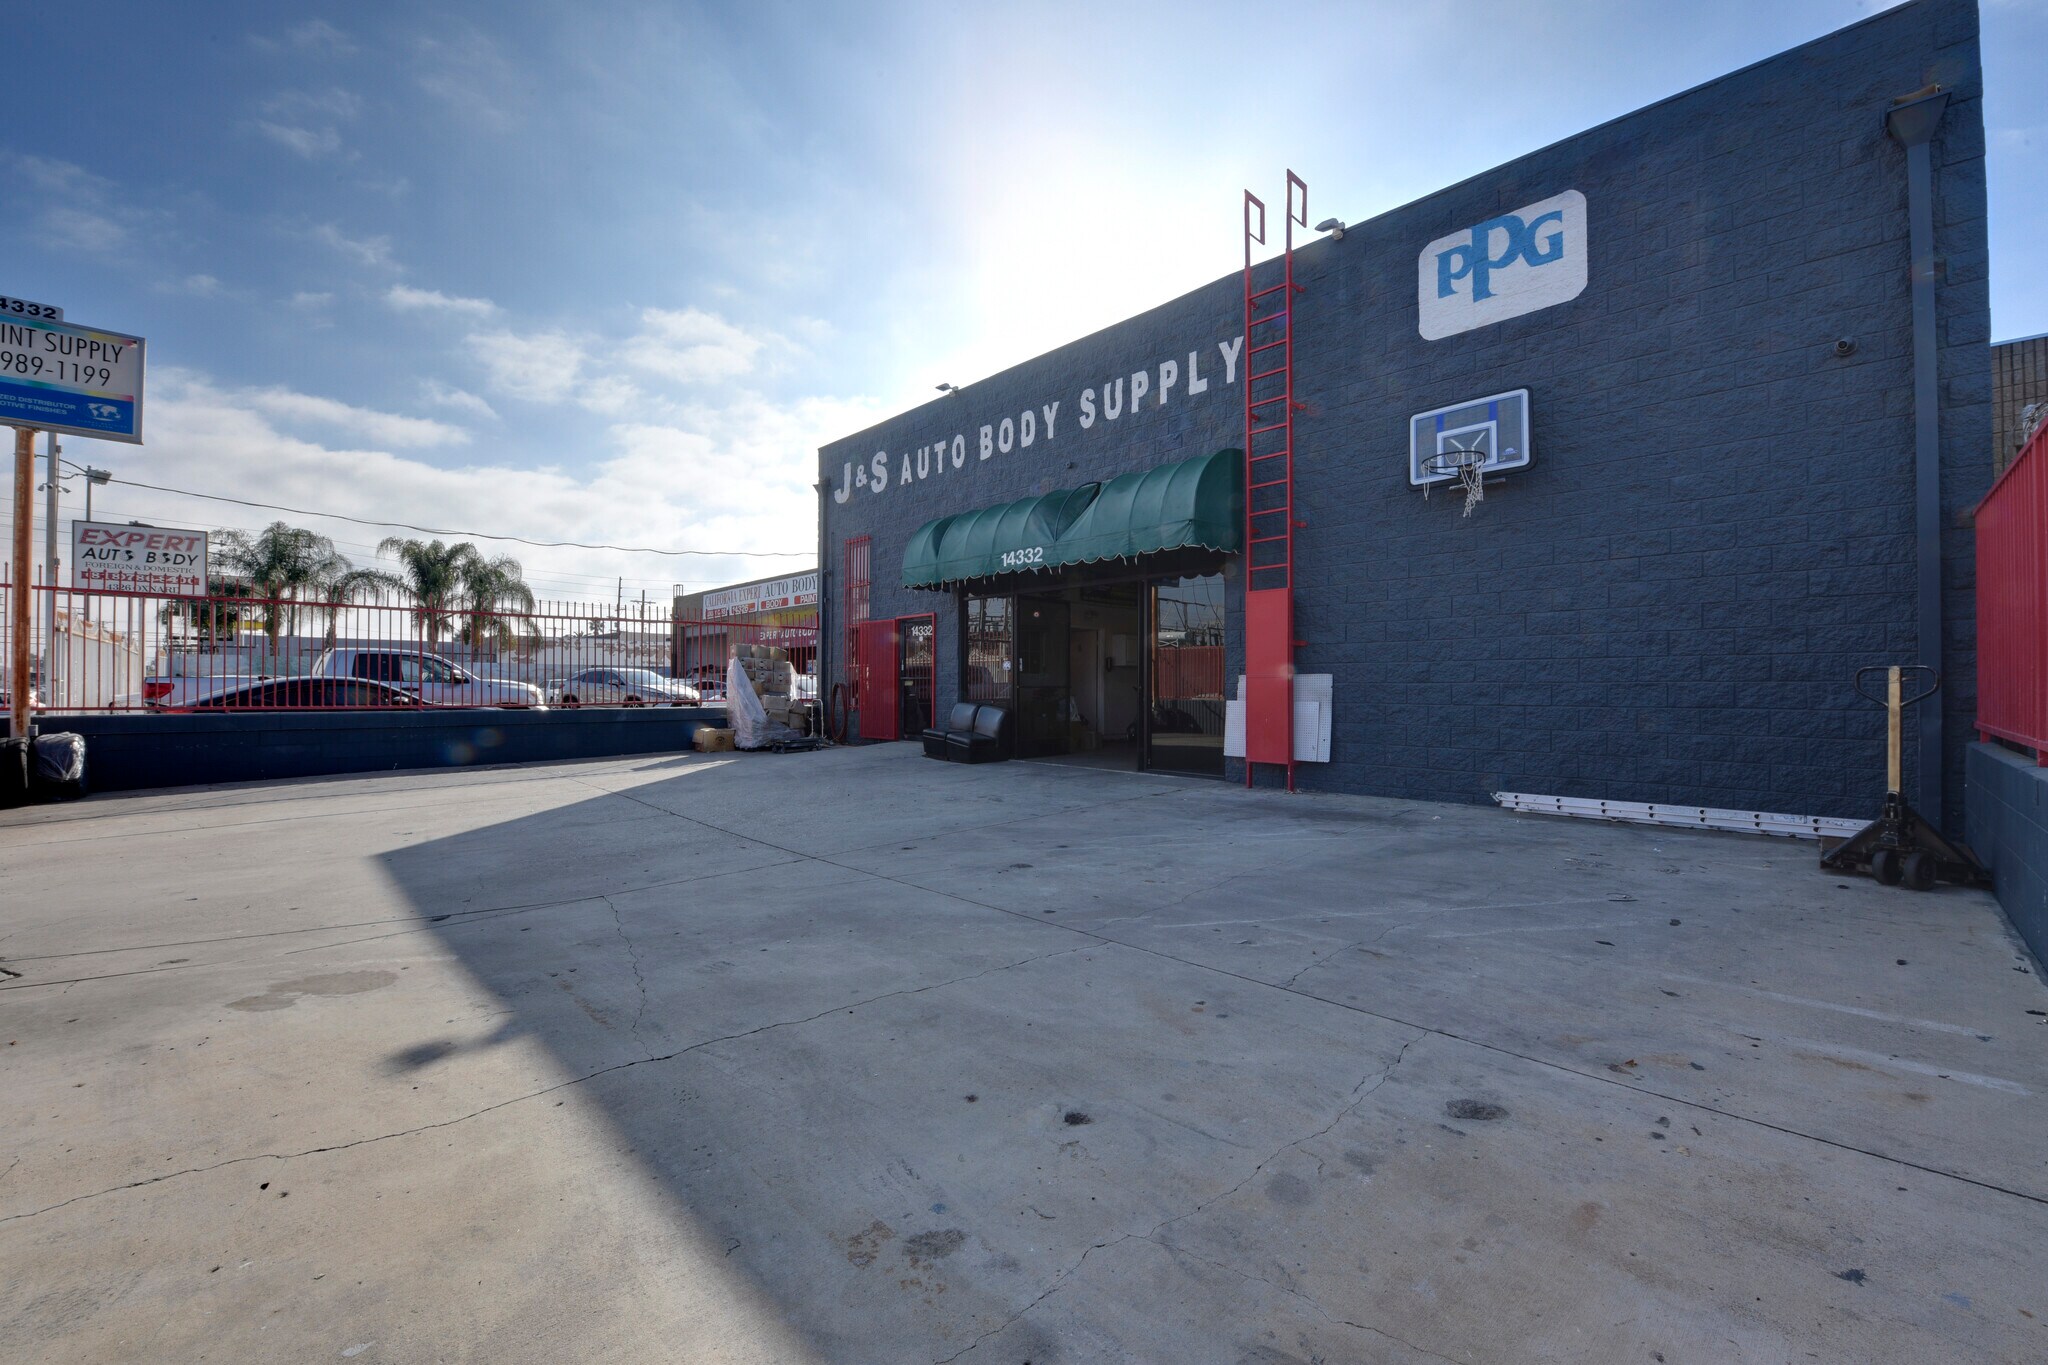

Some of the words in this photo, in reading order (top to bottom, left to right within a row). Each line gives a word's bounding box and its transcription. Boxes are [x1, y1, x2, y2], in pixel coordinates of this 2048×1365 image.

[1435, 210, 1564, 303] PPG
[45, 332, 123, 363] SUPPLY
[0, 351, 111, 387] 989-1199
[18, 396, 77, 410] DISTRIBUTOR
[27, 404, 68, 415] FINISHES
[834, 450, 889, 504] J&S
[900, 434, 966, 486] AUTO
[979, 401, 1060, 461] BODY
[1079, 335, 1245, 430] SUPPLY
[78, 528, 202, 552] EXPERT
[85, 561, 135, 570] FOREIGN
[143, 565, 195, 574] DOMESTIC
[1001, 547, 1044, 568] 14332
[705, 590, 737, 608] CALIFORNIA
[739, 585, 762, 601] EXPERT
[765, 581, 789, 598] AUTO
[792, 575, 817, 593] BODY
[766, 598, 783, 608] BODY
[911, 625, 933, 636] 14332
